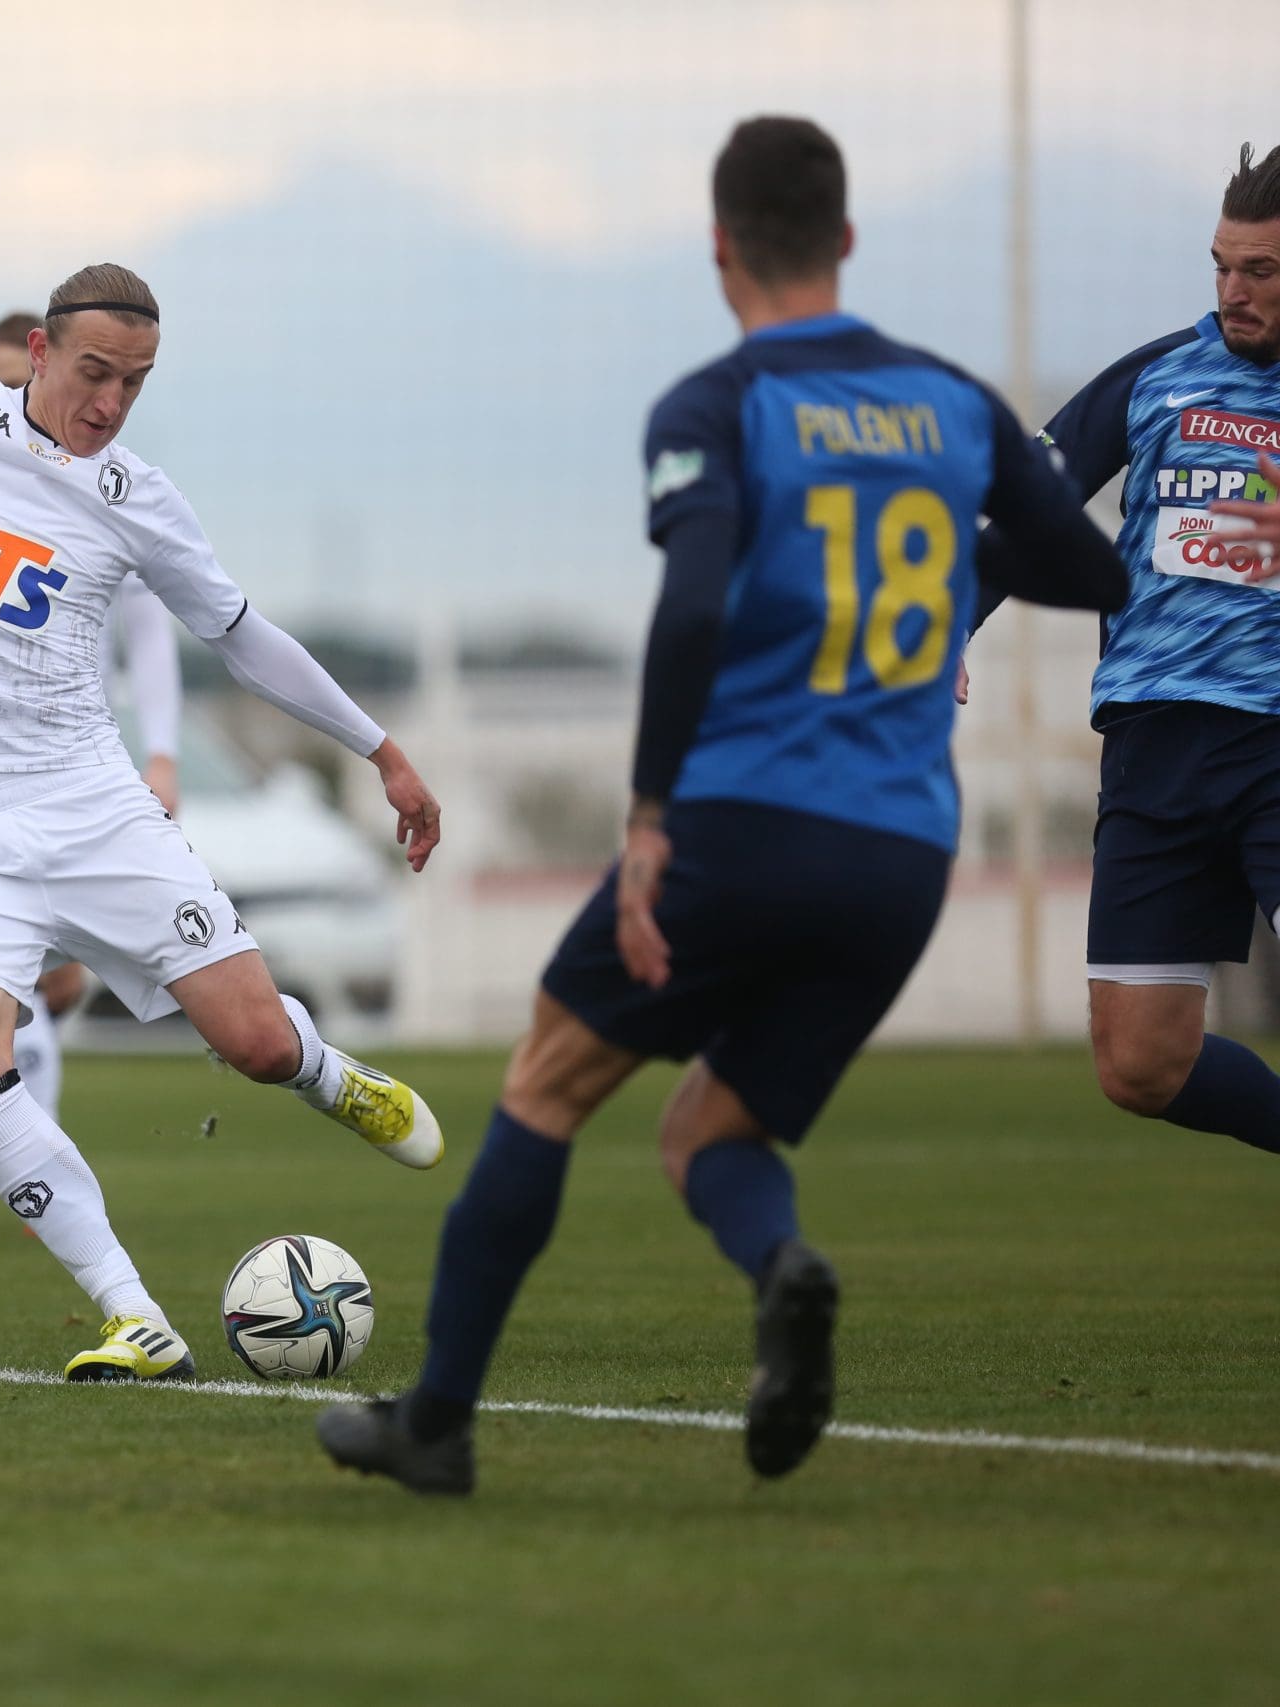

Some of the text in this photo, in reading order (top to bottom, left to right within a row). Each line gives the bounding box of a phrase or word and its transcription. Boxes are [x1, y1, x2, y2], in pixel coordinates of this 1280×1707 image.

[1186, 414, 1280, 447] HUNGA
[1157, 468, 1278, 504] TiPPM
[1179, 517, 1214, 531] HONI
[804, 485, 957, 695] 18
